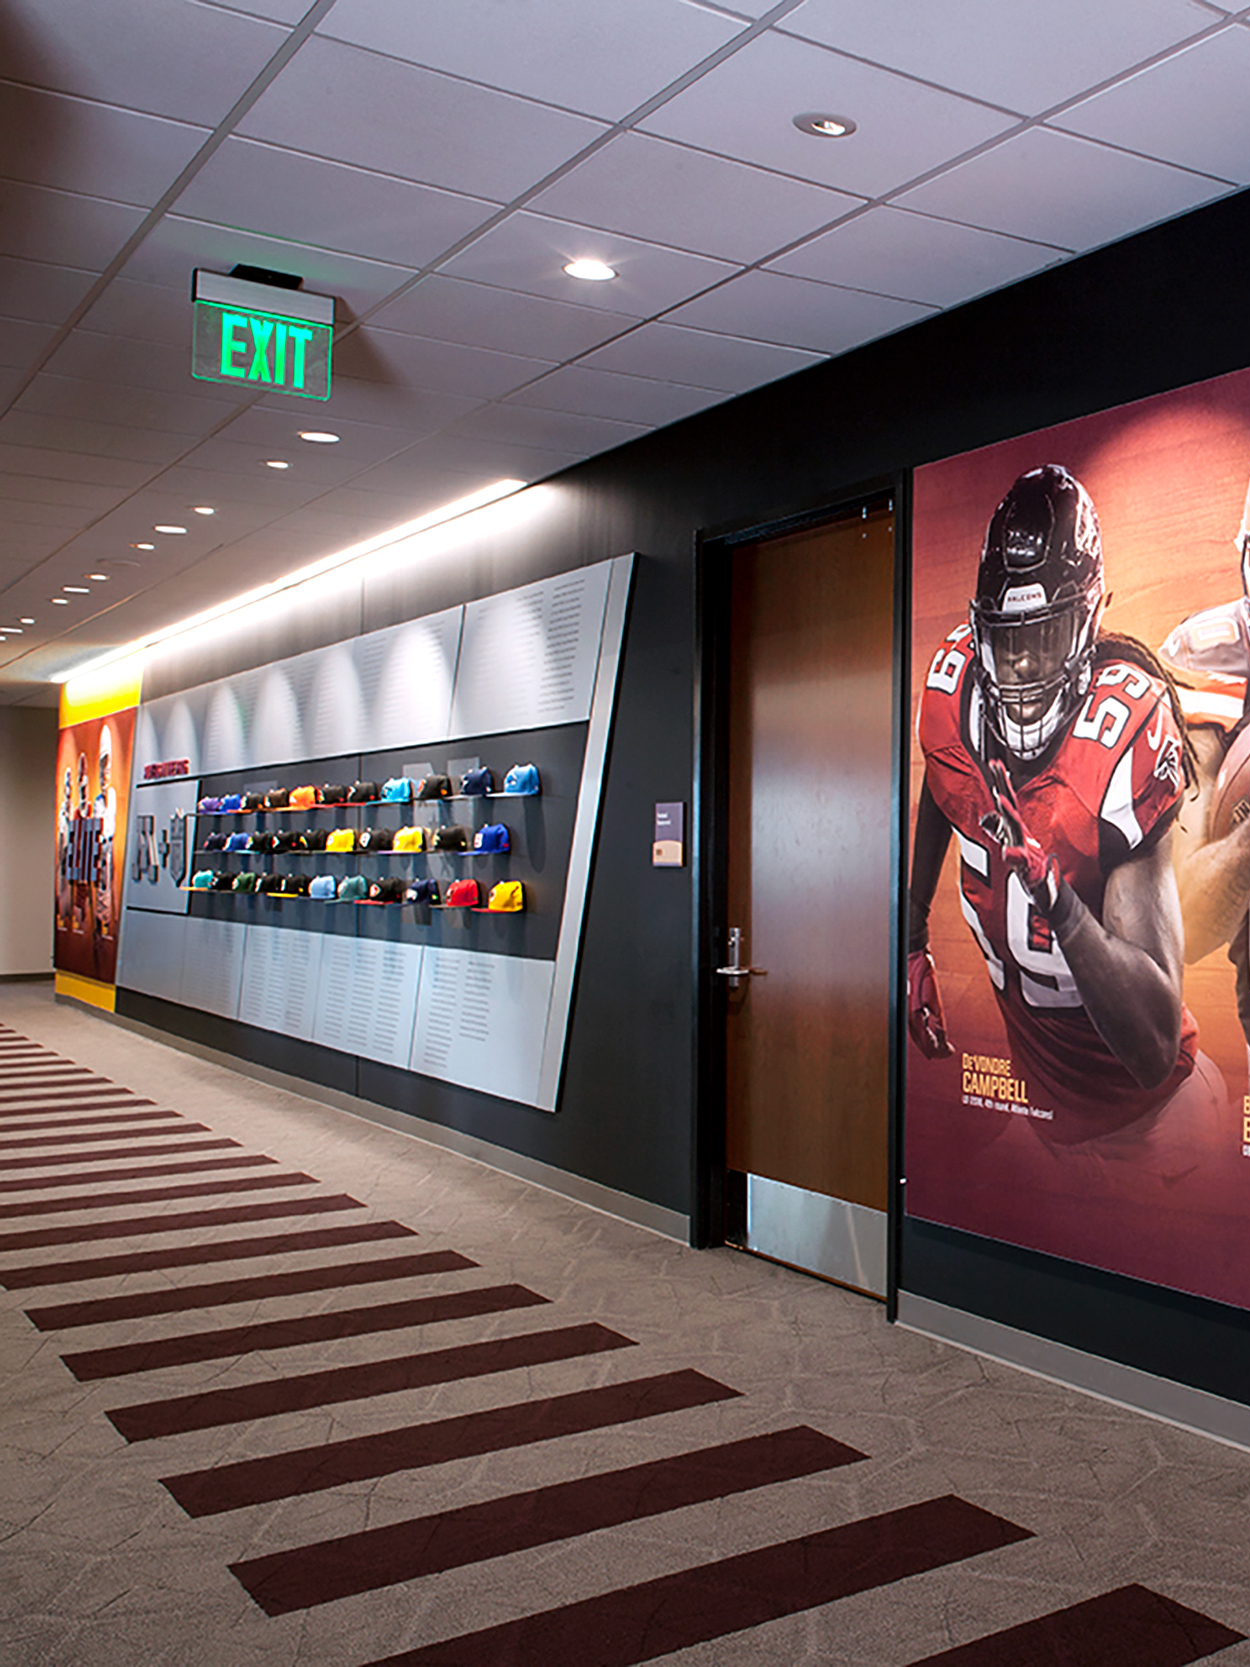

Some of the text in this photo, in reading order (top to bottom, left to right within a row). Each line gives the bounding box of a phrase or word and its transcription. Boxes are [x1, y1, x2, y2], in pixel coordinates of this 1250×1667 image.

[221, 312, 312, 388] EXIT
[1072, 663, 1151, 750] 59
[962, 1071, 1029, 1103] CAMPBELL
